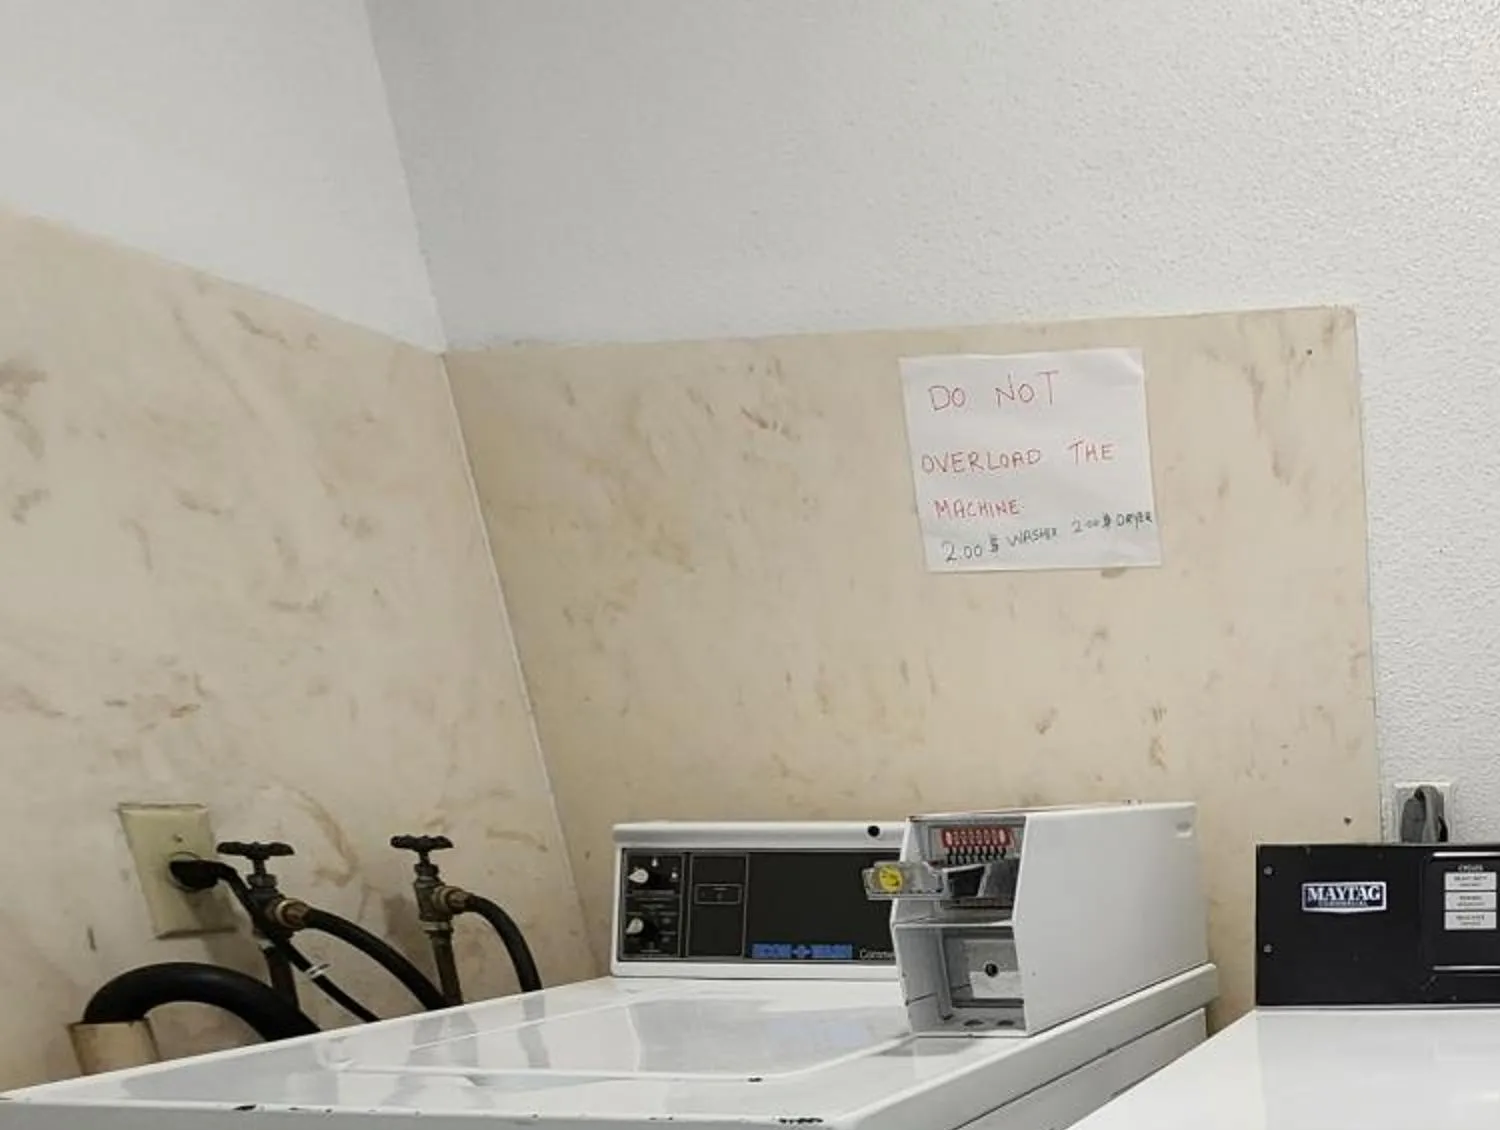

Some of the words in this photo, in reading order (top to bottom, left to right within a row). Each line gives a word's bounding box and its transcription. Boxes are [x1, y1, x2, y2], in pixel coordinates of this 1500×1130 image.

[928, 385, 966, 411] DO
[995, 370, 1060, 408] NOT
[921, 448, 1042, 474] OVERLOAD
[1069, 439, 1115, 466] THE
[934, 499, 1020, 520] MACHINE
[941, 540, 983, 562] 2.00
[1116, 511, 1153, 529] DRYER
[1307, 885, 1381, 902] MAYTAG
